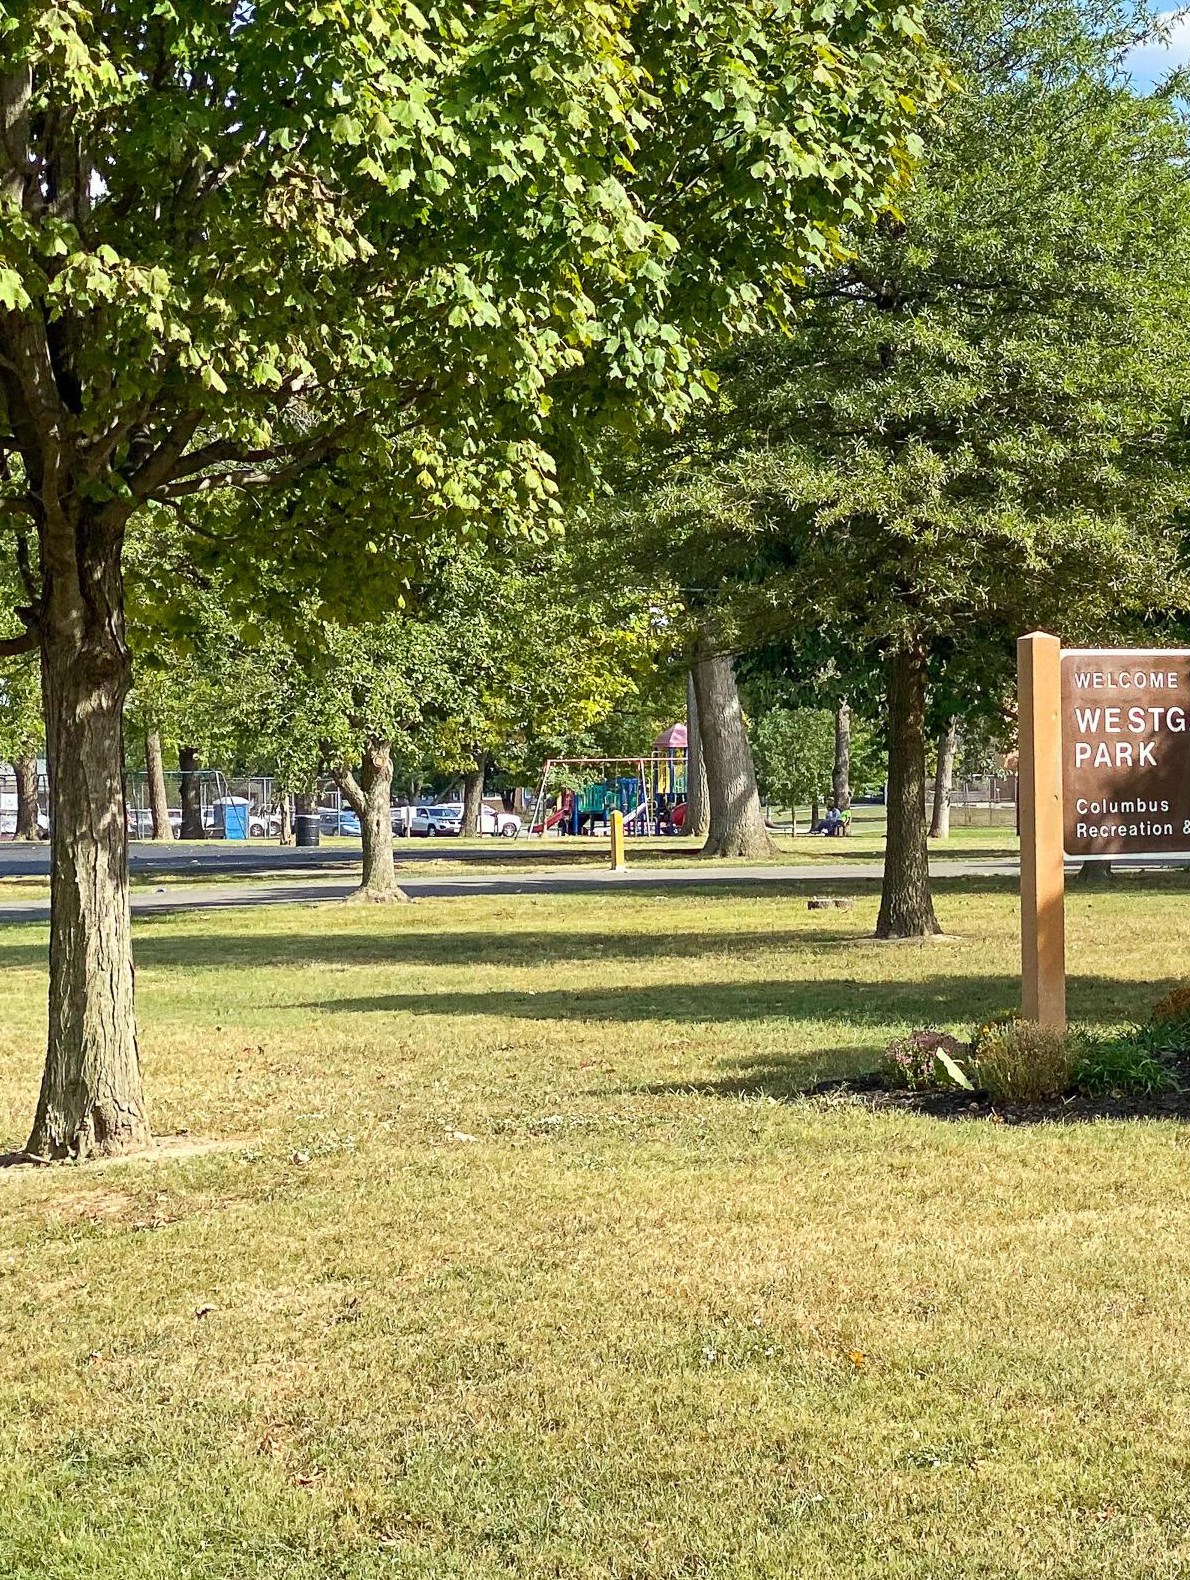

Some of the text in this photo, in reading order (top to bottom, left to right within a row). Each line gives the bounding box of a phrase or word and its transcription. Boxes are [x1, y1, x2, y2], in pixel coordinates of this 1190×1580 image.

[1075, 671, 1179, 689] WELCOME
[1075, 741, 1157, 767] PARK
[1076, 798, 1169, 814] Columbus
[1076, 822, 1173, 838] Recreation
